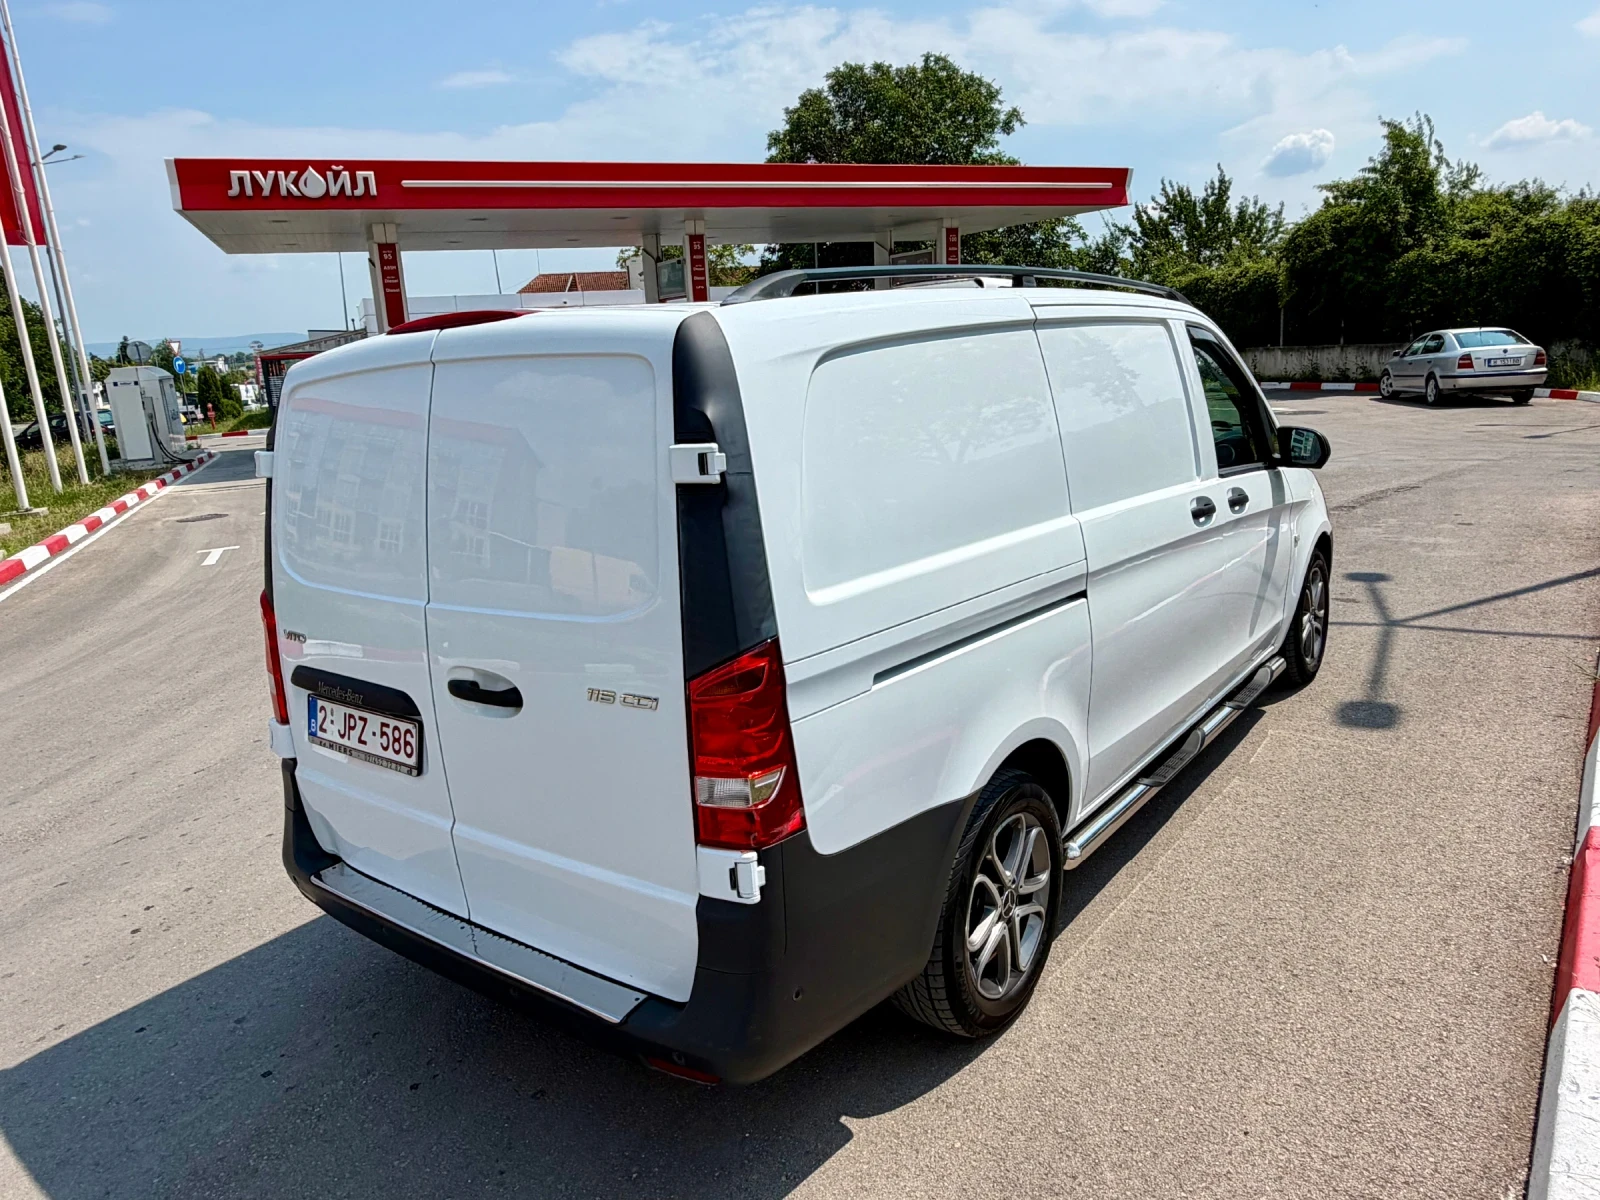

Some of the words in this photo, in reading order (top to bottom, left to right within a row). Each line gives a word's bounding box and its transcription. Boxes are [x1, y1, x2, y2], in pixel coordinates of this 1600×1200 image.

[227, 164, 378, 198] ЛУКОЙЛ
[318, 680, 364, 705] Mercedes-Benz
[619, 693, 660, 711] CDI
[310, 719, 316, 732] B
